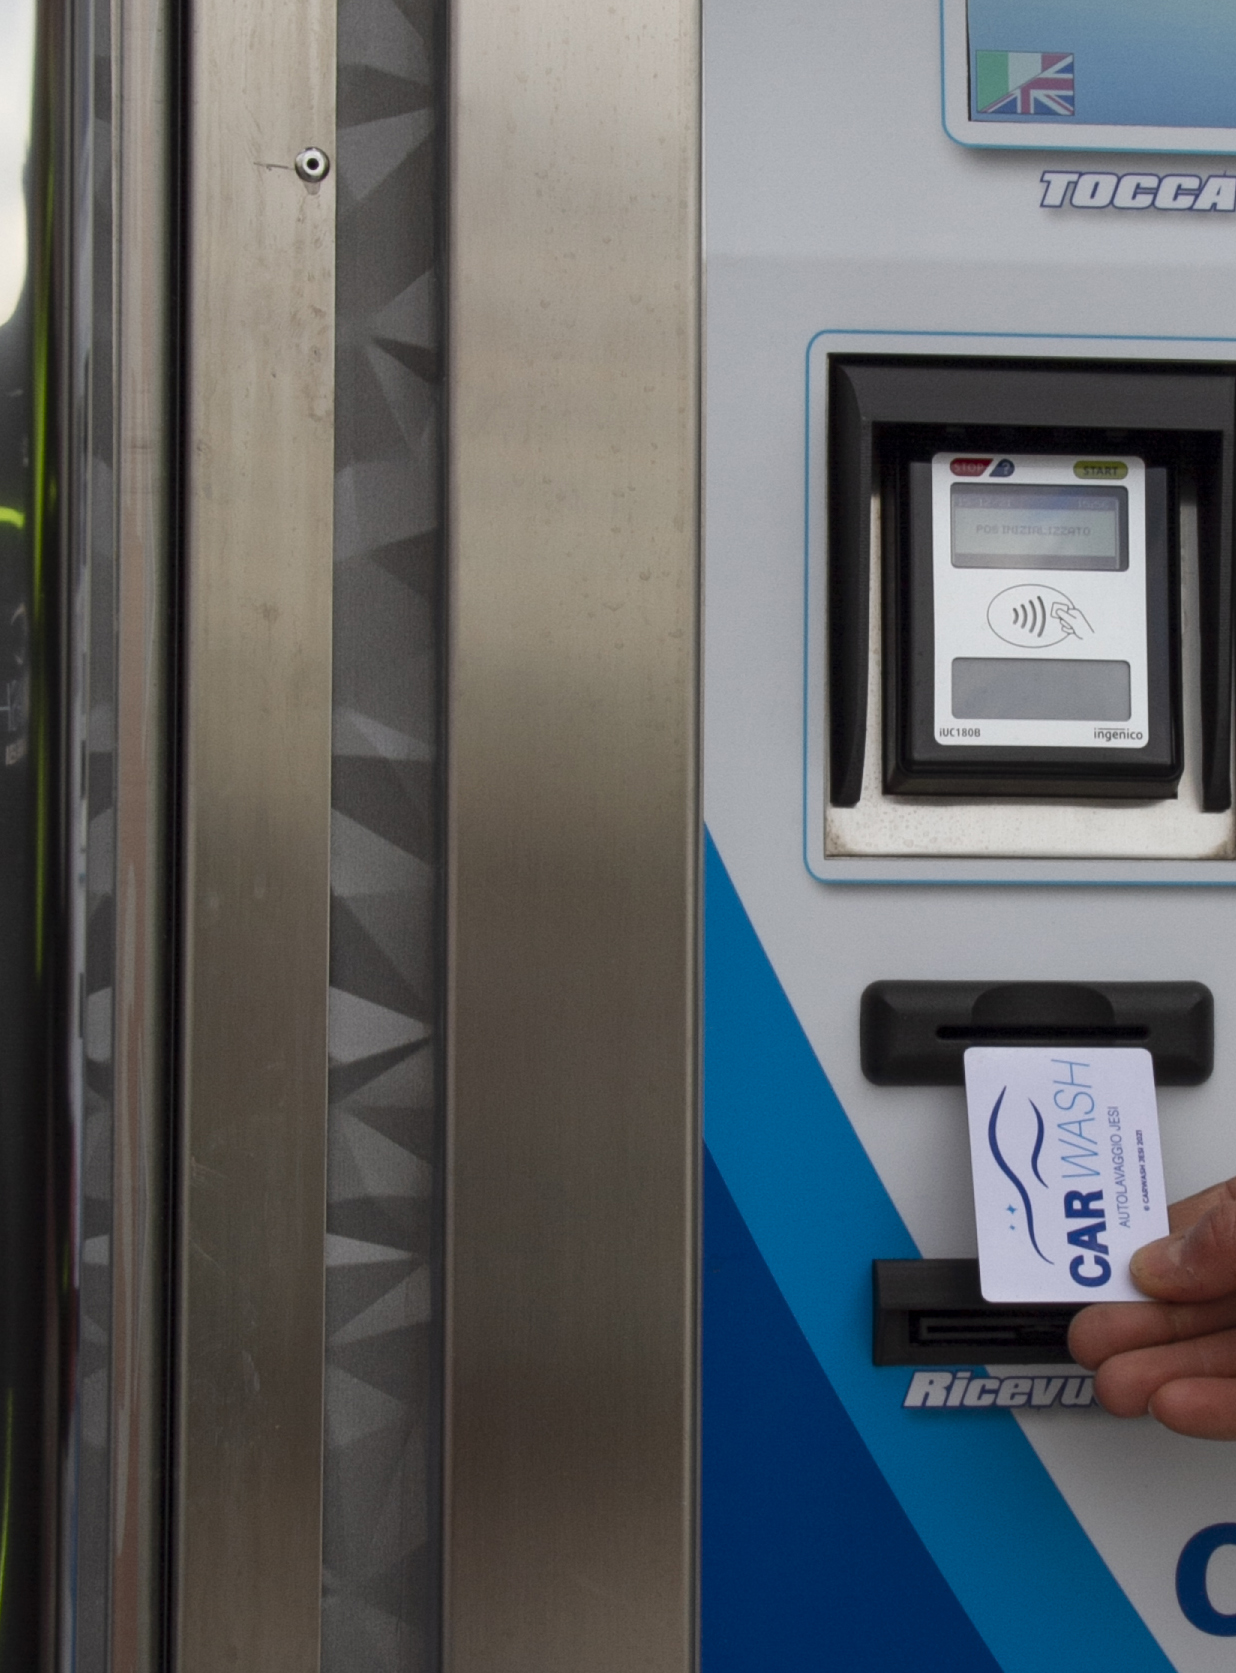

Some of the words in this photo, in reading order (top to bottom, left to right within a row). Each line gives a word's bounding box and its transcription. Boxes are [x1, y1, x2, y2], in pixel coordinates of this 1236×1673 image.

[954, 462, 984, 474] STOP
[1083, 466, 1119, 476] START
[939, 728, 981, 737] iUC180B
[1094, 728, 1143, 741] ingenico
[1051, 1059, 1100, 1178] WASH
[1107, 1106, 1121, 1131] JESI
[1110, 1133, 1130, 1228] AUTOLAVAGGIO
[1064, 1189, 1112, 1287] CAR
[903, 1370, 1099, 1409] Ricevu
